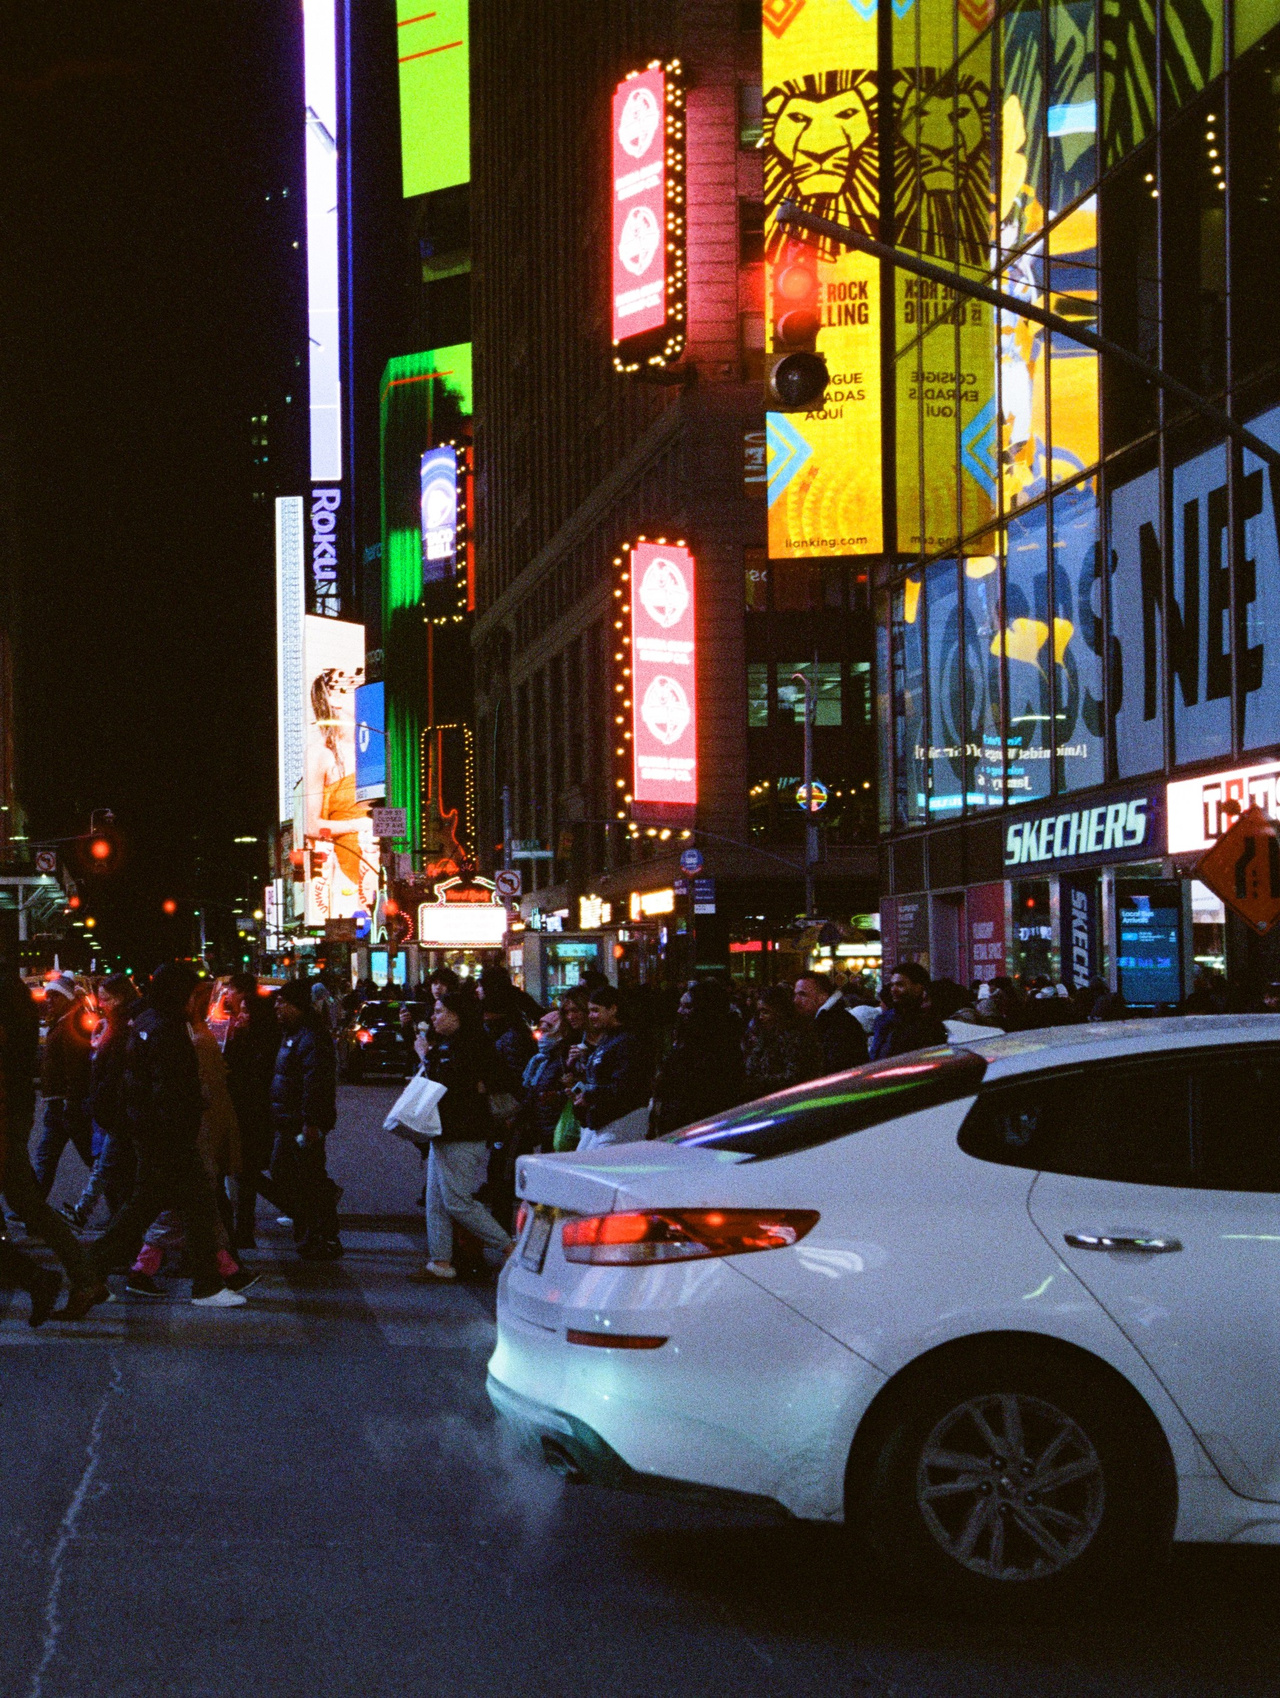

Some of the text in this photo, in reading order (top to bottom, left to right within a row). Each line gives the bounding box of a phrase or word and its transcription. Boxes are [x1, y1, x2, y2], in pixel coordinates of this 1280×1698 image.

[827, 280, 869, 302] ROCK
[820, 302, 869, 327] LING
[826, 389, 866, 402] ADAS
[1005, 799, 1148, 866] SKECHERS
[1070, 888, 1090, 990] SKECH
